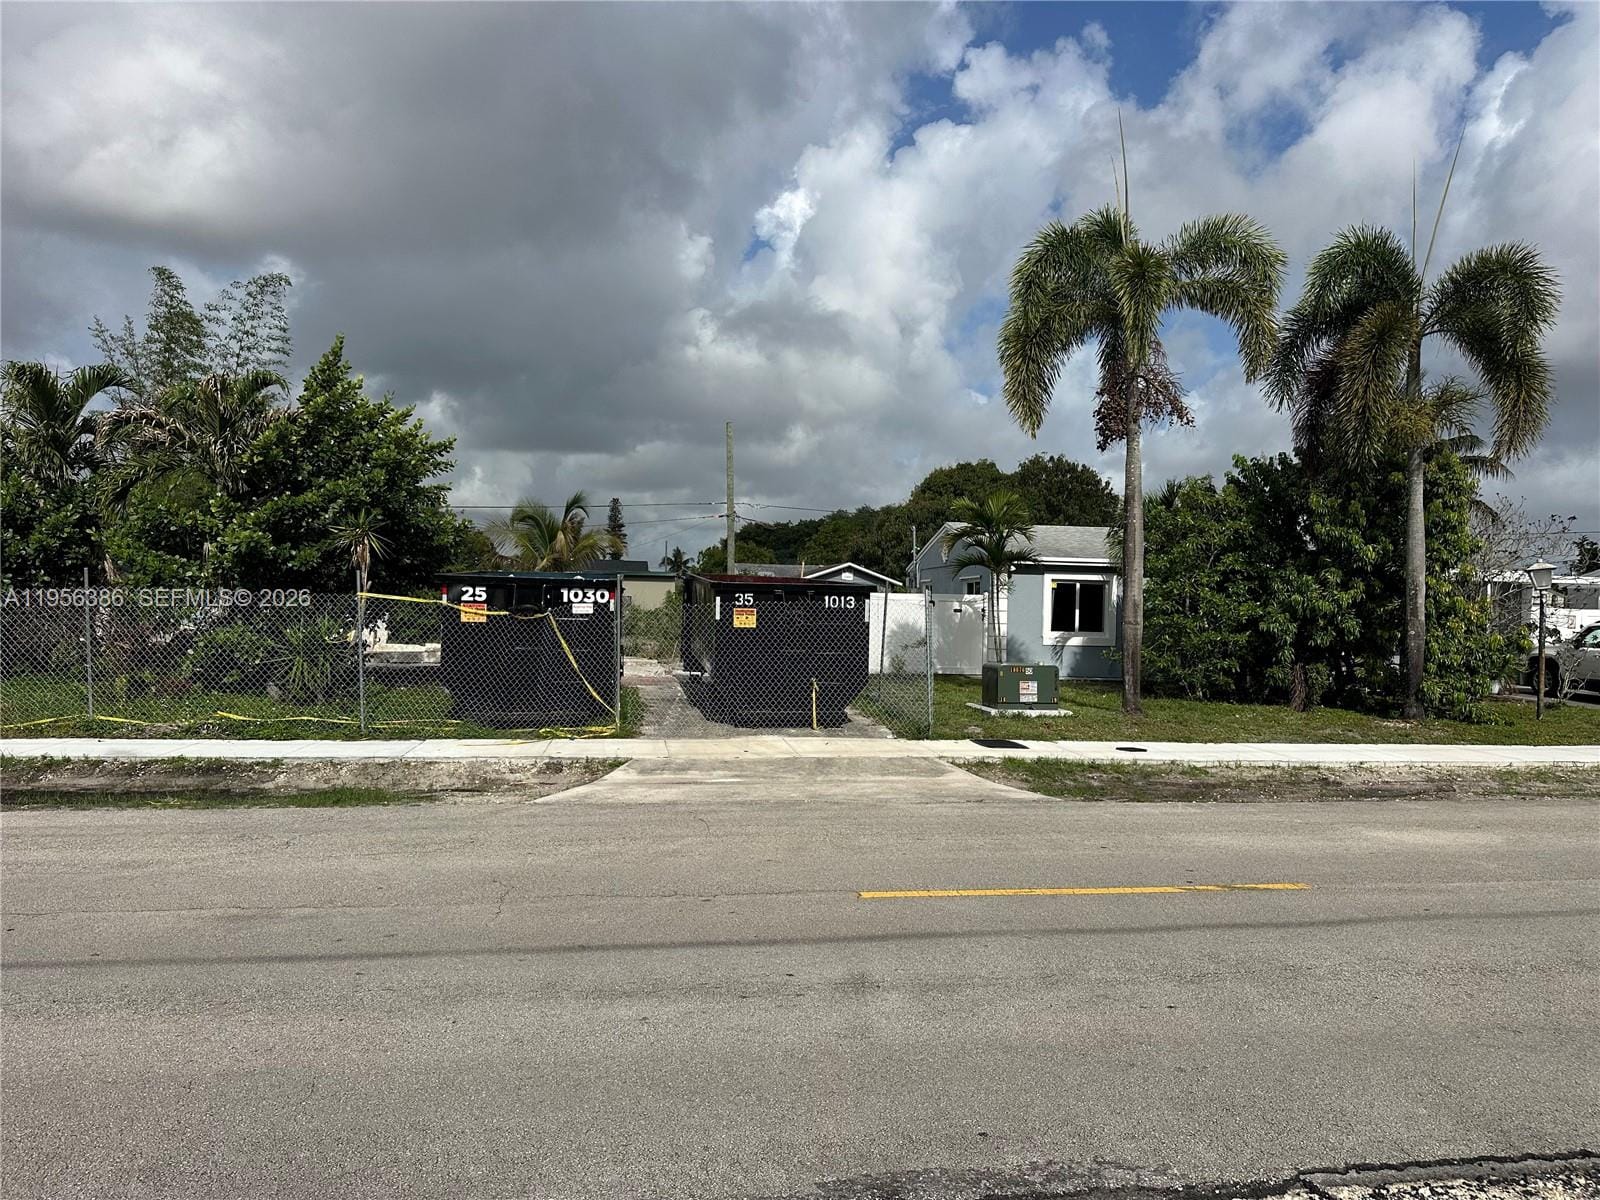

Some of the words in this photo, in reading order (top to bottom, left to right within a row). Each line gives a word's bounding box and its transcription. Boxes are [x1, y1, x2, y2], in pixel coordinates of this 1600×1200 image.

[460, 586, 487, 601] 25
[560, 588, 610, 603] 1030
[735, 593, 754, 605] 35
[824, 595, 855, 609] 1013
